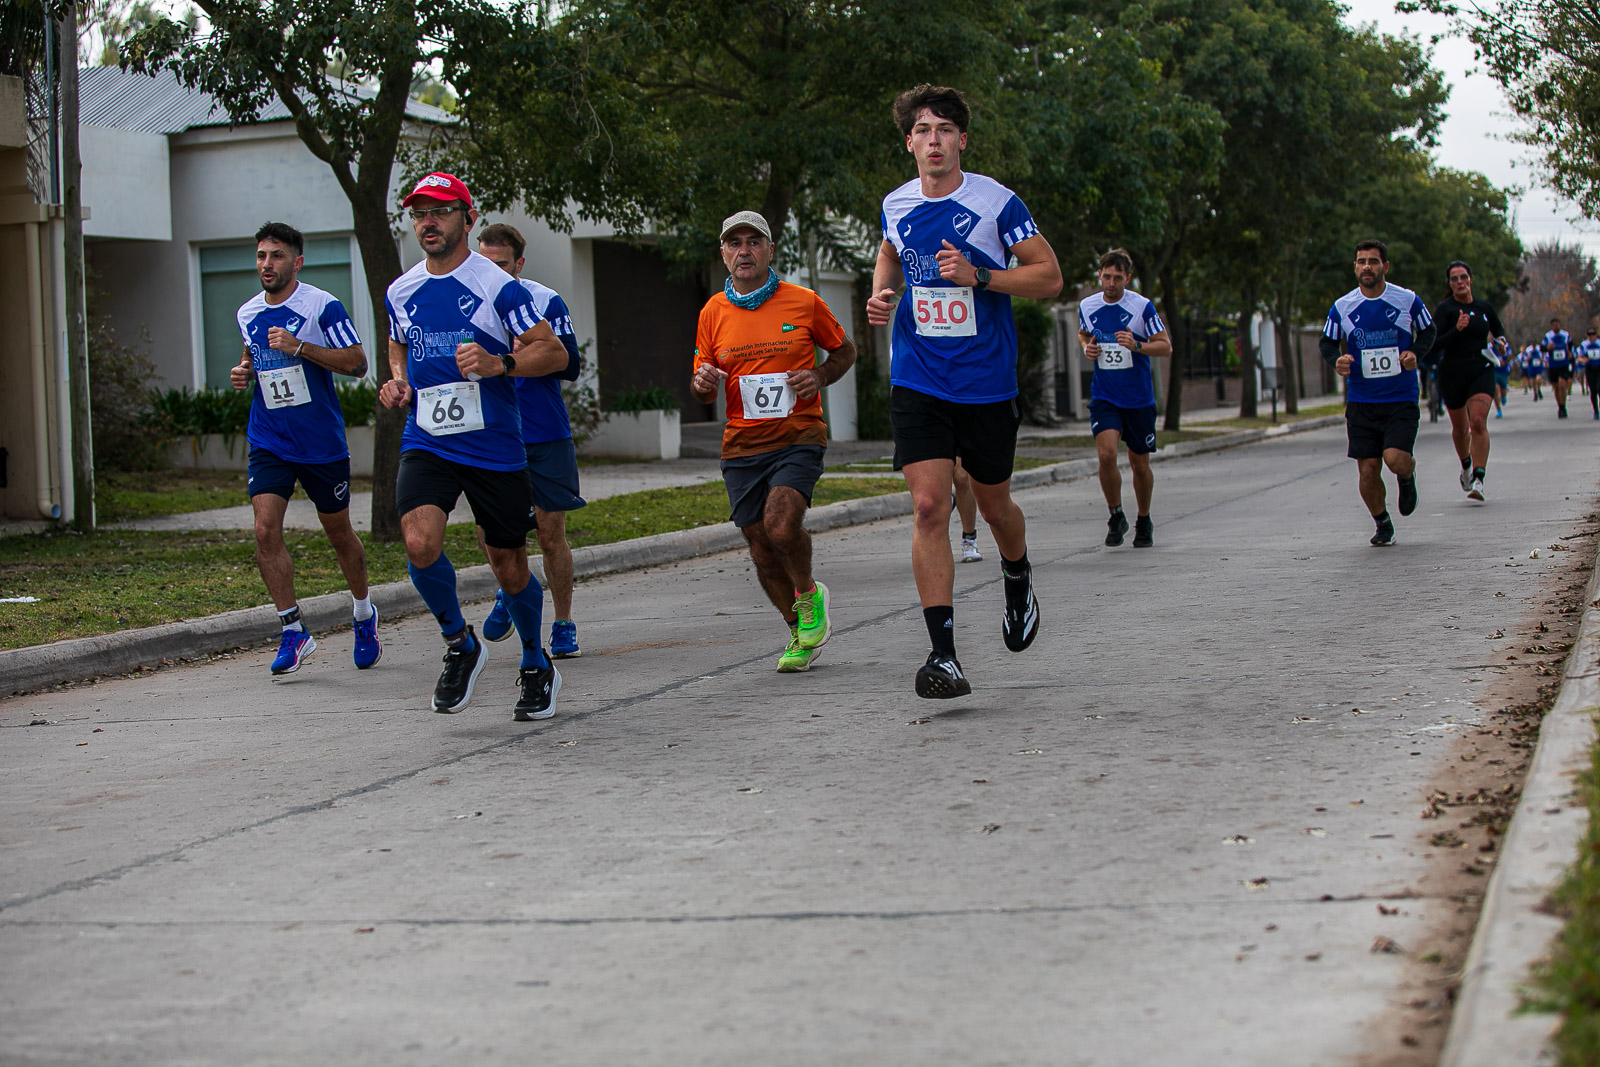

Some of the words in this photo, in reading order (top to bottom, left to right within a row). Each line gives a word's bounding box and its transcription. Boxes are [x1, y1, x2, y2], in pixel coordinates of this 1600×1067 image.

[903, 249, 922, 284] 3
[917, 300, 968, 325] 510
[409, 325, 425, 362] 3
[730, 343, 754, 353] Maratón
[754, 339, 793, 349] Internacional
[1353, 327, 1367, 349] 3
[250, 343, 262, 372] 3
[1105, 350, 1123, 363] 33
[1370, 356, 1391, 371] 10
[269, 379, 295, 399] 11
[755, 385, 784, 408] 67
[432, 397, 465, 424] 66
